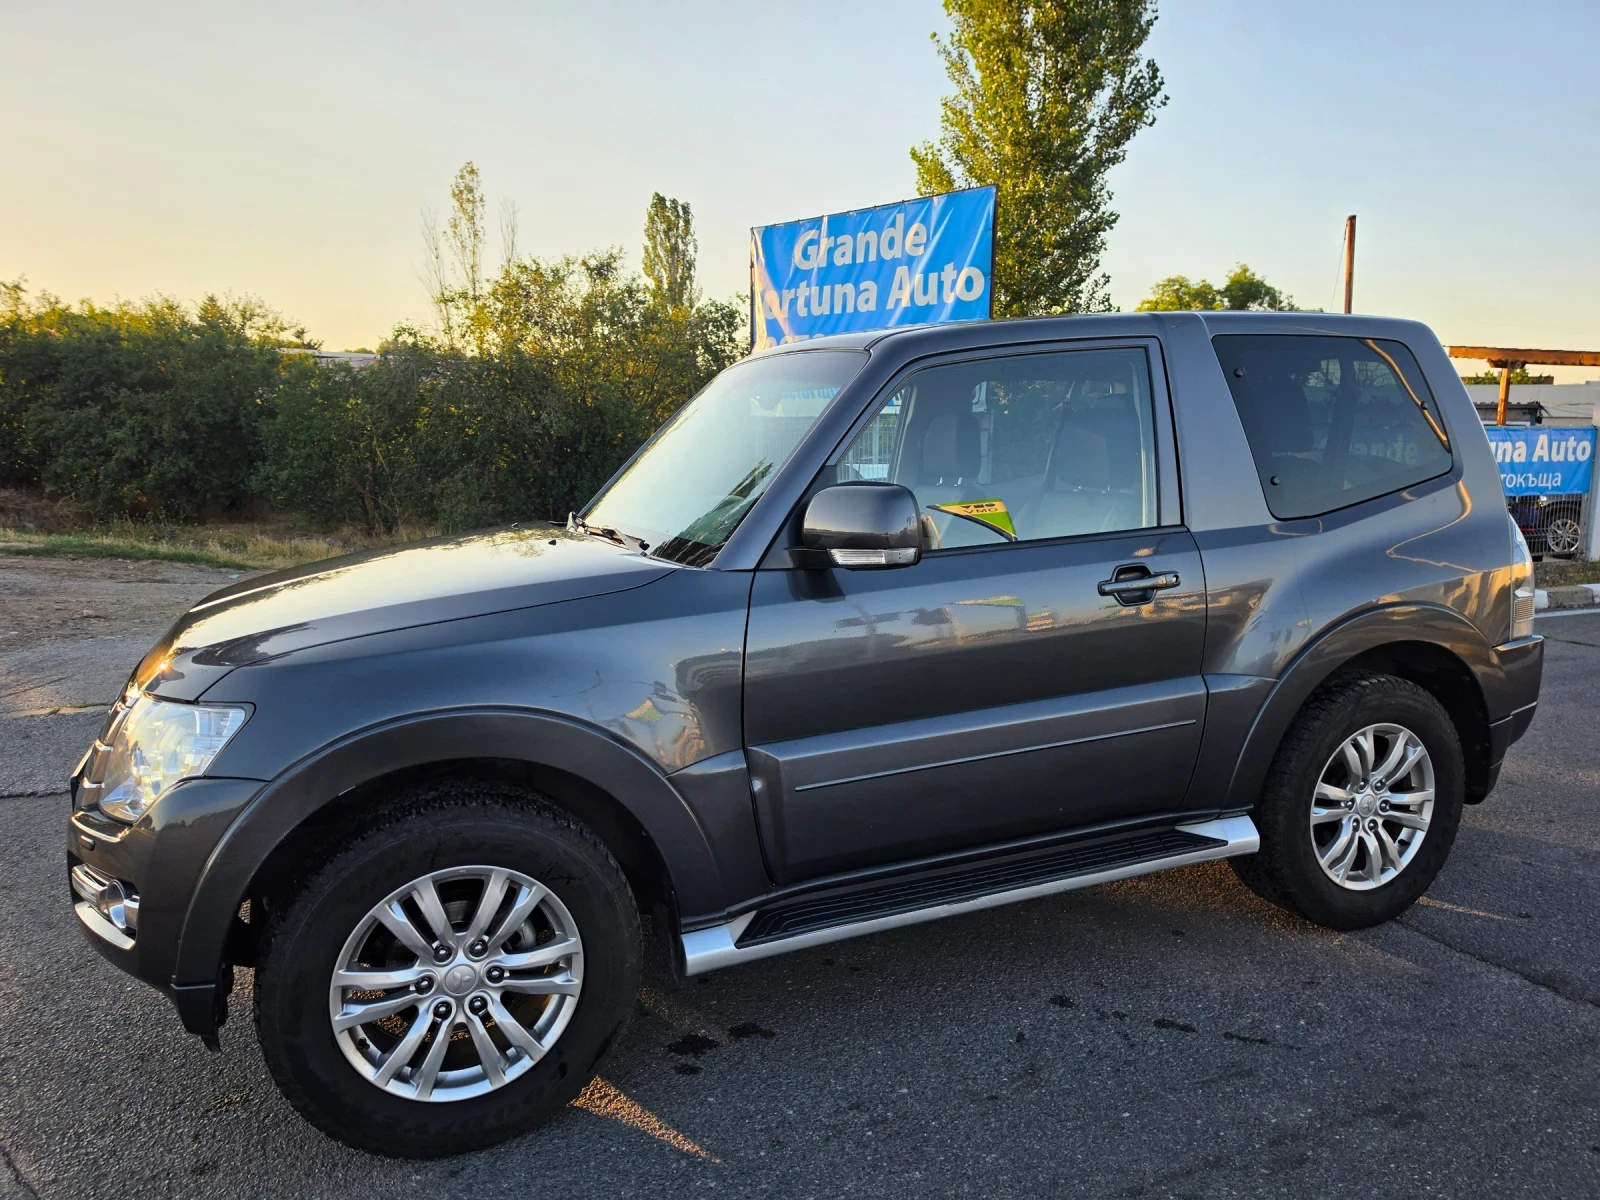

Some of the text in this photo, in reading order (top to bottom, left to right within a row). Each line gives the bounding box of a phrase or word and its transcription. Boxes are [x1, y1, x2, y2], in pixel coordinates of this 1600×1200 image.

[794, 214, 927, 270] Grande
[763, 261, 986, 321] ortuna Auto
[1532, 433, 1592, 463] Auto
